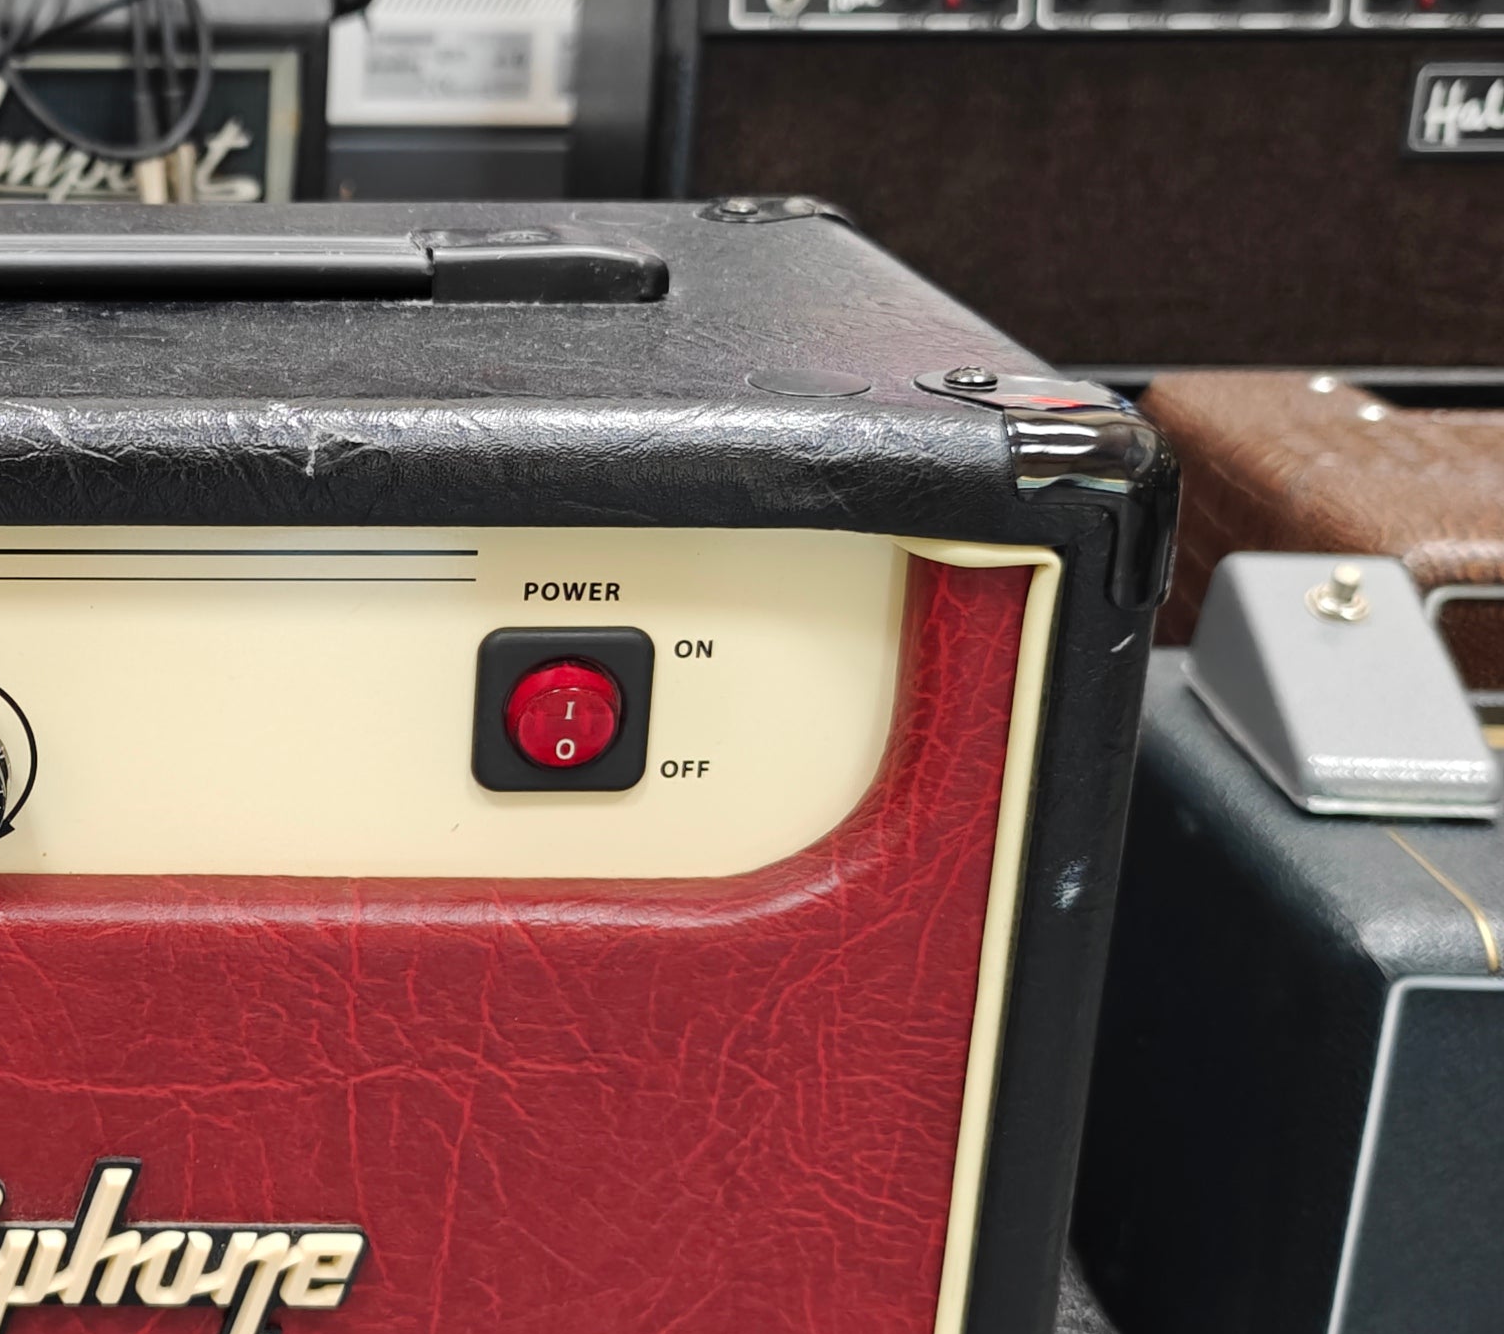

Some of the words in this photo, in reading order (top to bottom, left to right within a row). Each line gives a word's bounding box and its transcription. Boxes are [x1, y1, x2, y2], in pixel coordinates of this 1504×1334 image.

[523, 582, 620, 602] POWER
[674, 639, 713, 659] ON
[660, 760, 710, 779] OFF
